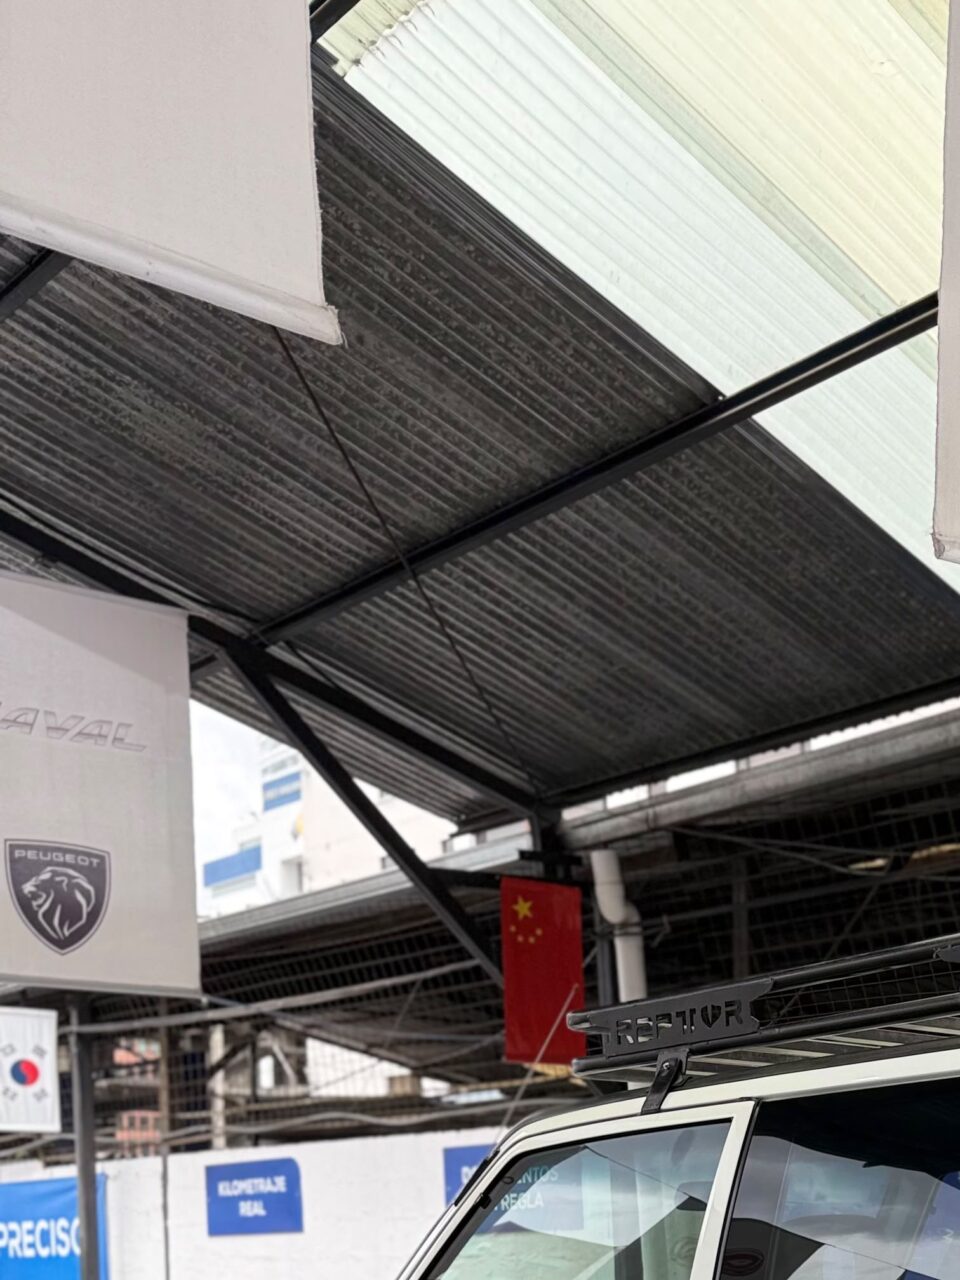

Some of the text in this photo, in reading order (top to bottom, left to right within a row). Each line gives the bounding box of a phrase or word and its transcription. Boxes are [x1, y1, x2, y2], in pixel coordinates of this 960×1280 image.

[0, 702, 147, 752] AVAL
[14, 849, 101, 868] PEUGEOT
[217, 1175, 287, 1196] KILOMETRAJE
[238, 1200, 267, 1217] REAL
